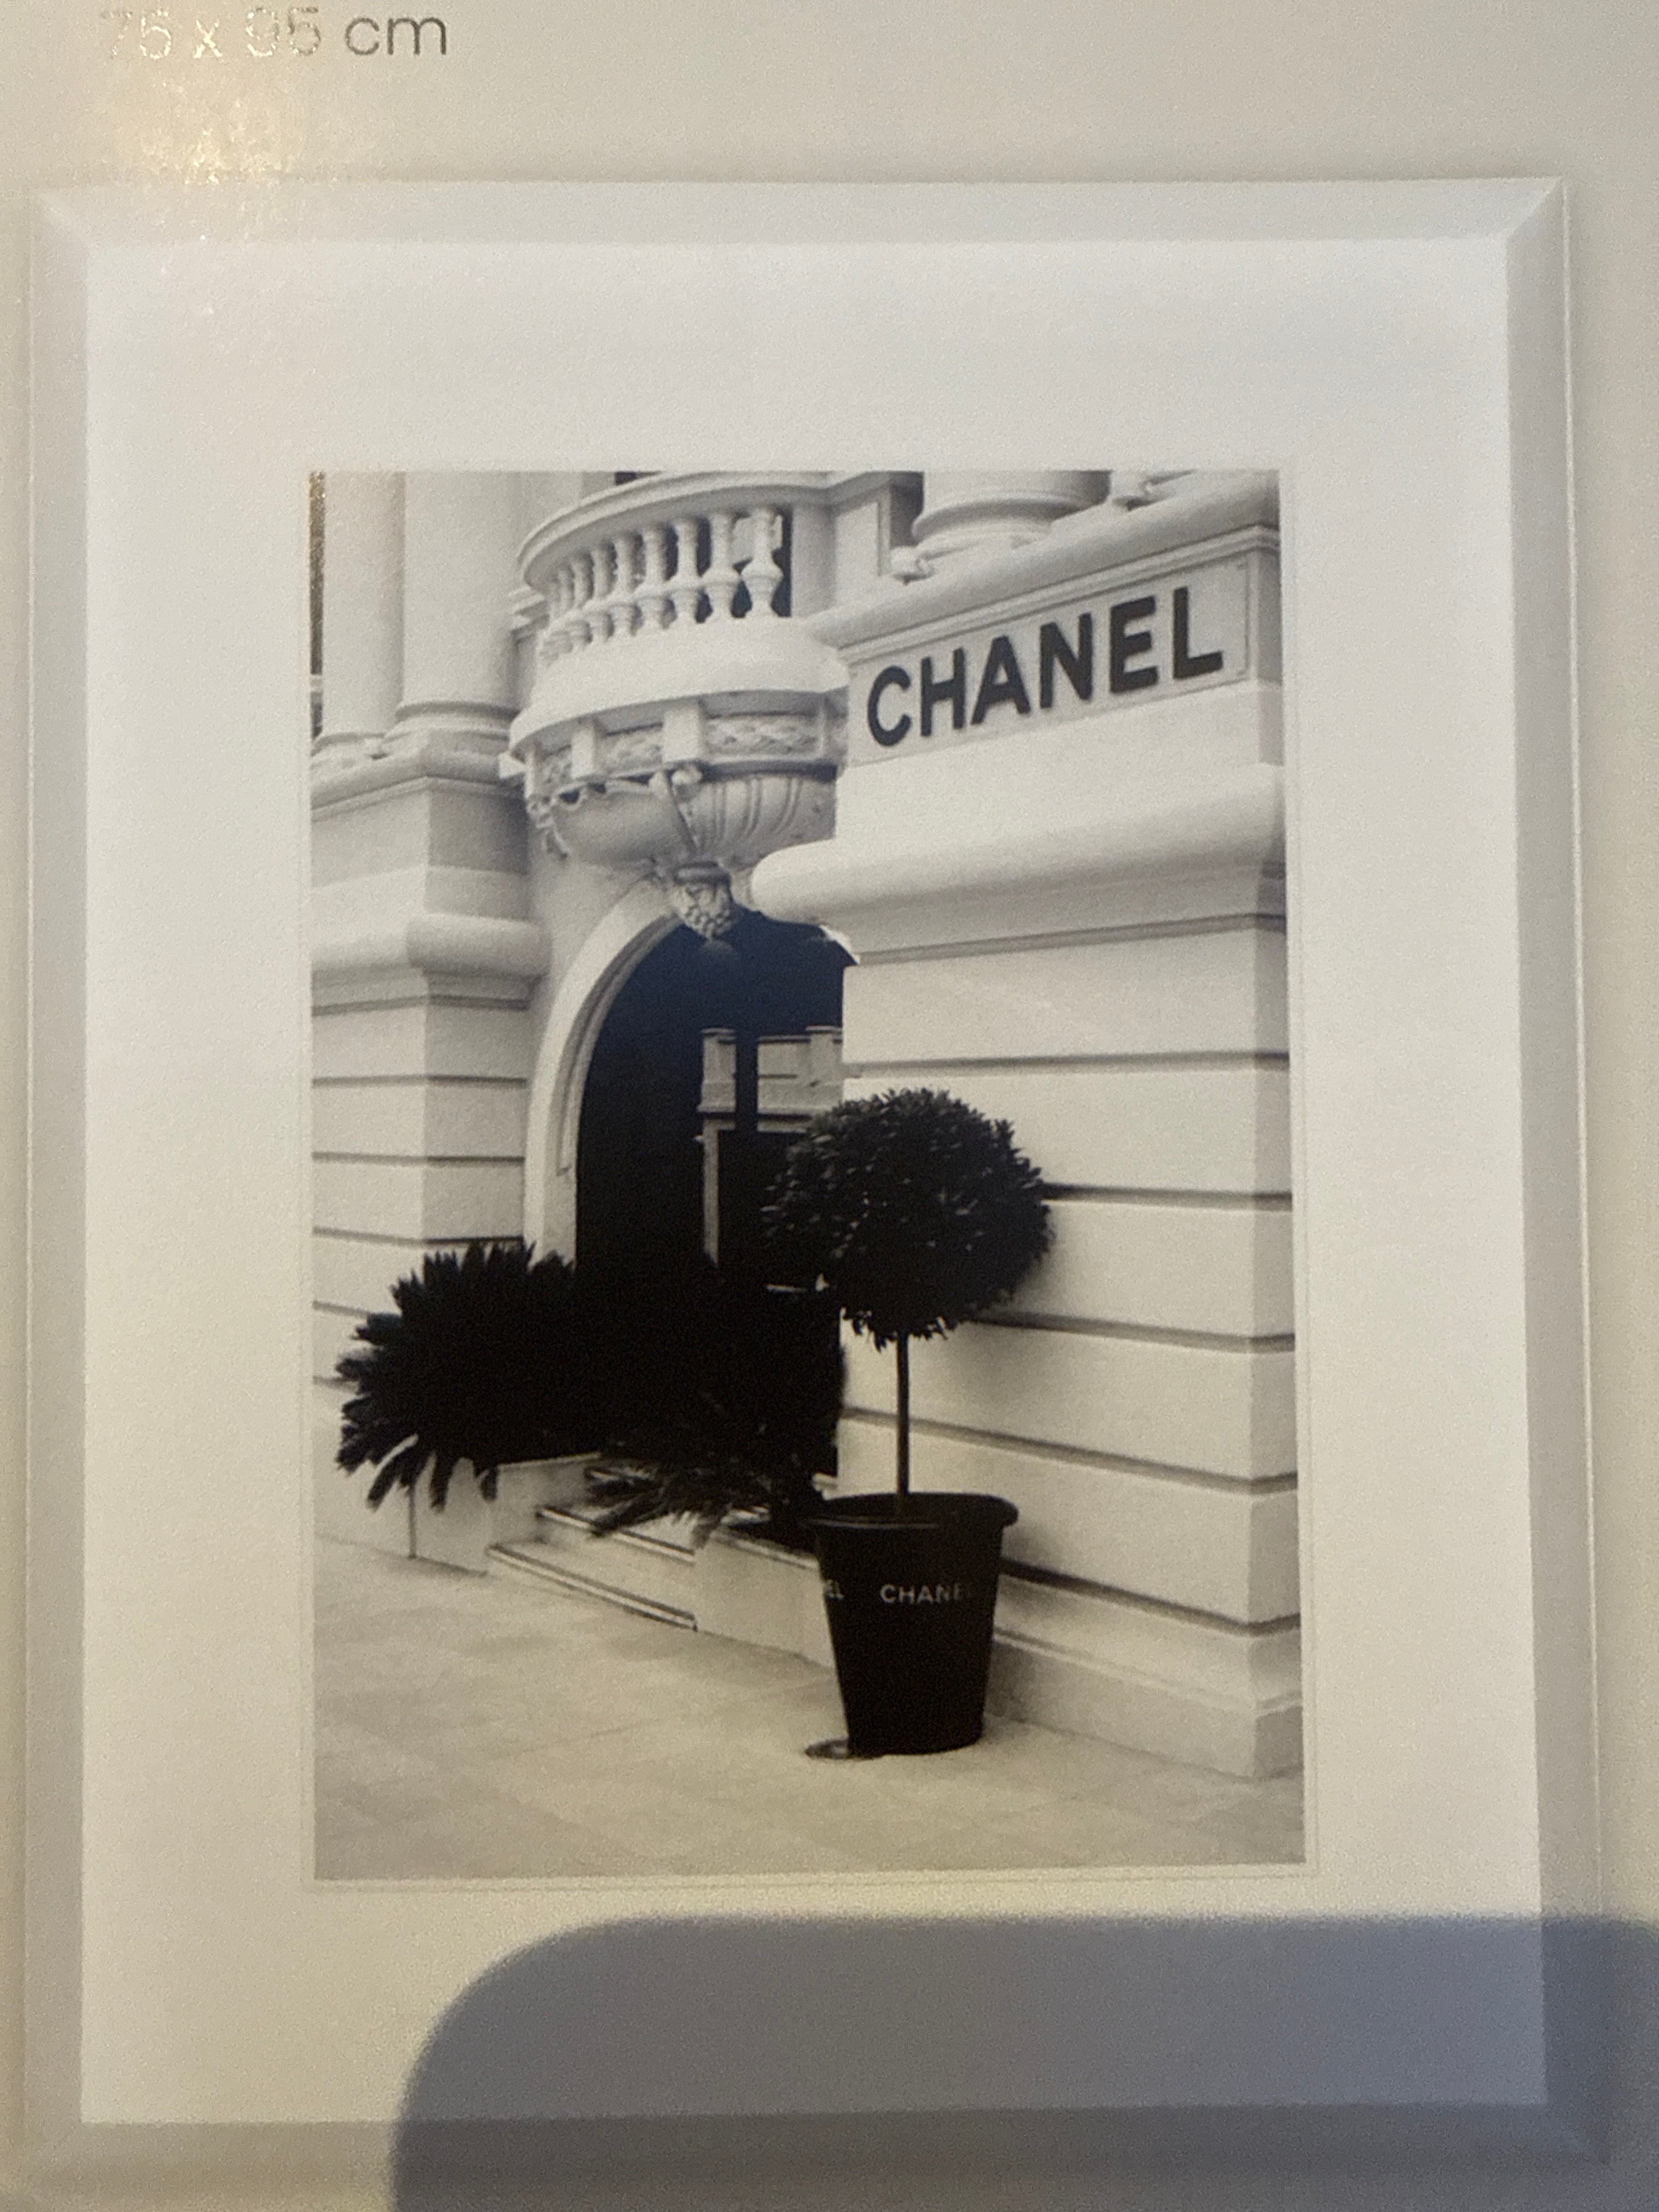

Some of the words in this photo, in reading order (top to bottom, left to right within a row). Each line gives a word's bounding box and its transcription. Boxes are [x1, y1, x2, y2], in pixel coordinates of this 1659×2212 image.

[193, 18, 223, 59] x
[245, 6, 322, 57] 95
[345, 16, 447, 56] cm
[867, 586, 1224, 747] CHANEL
